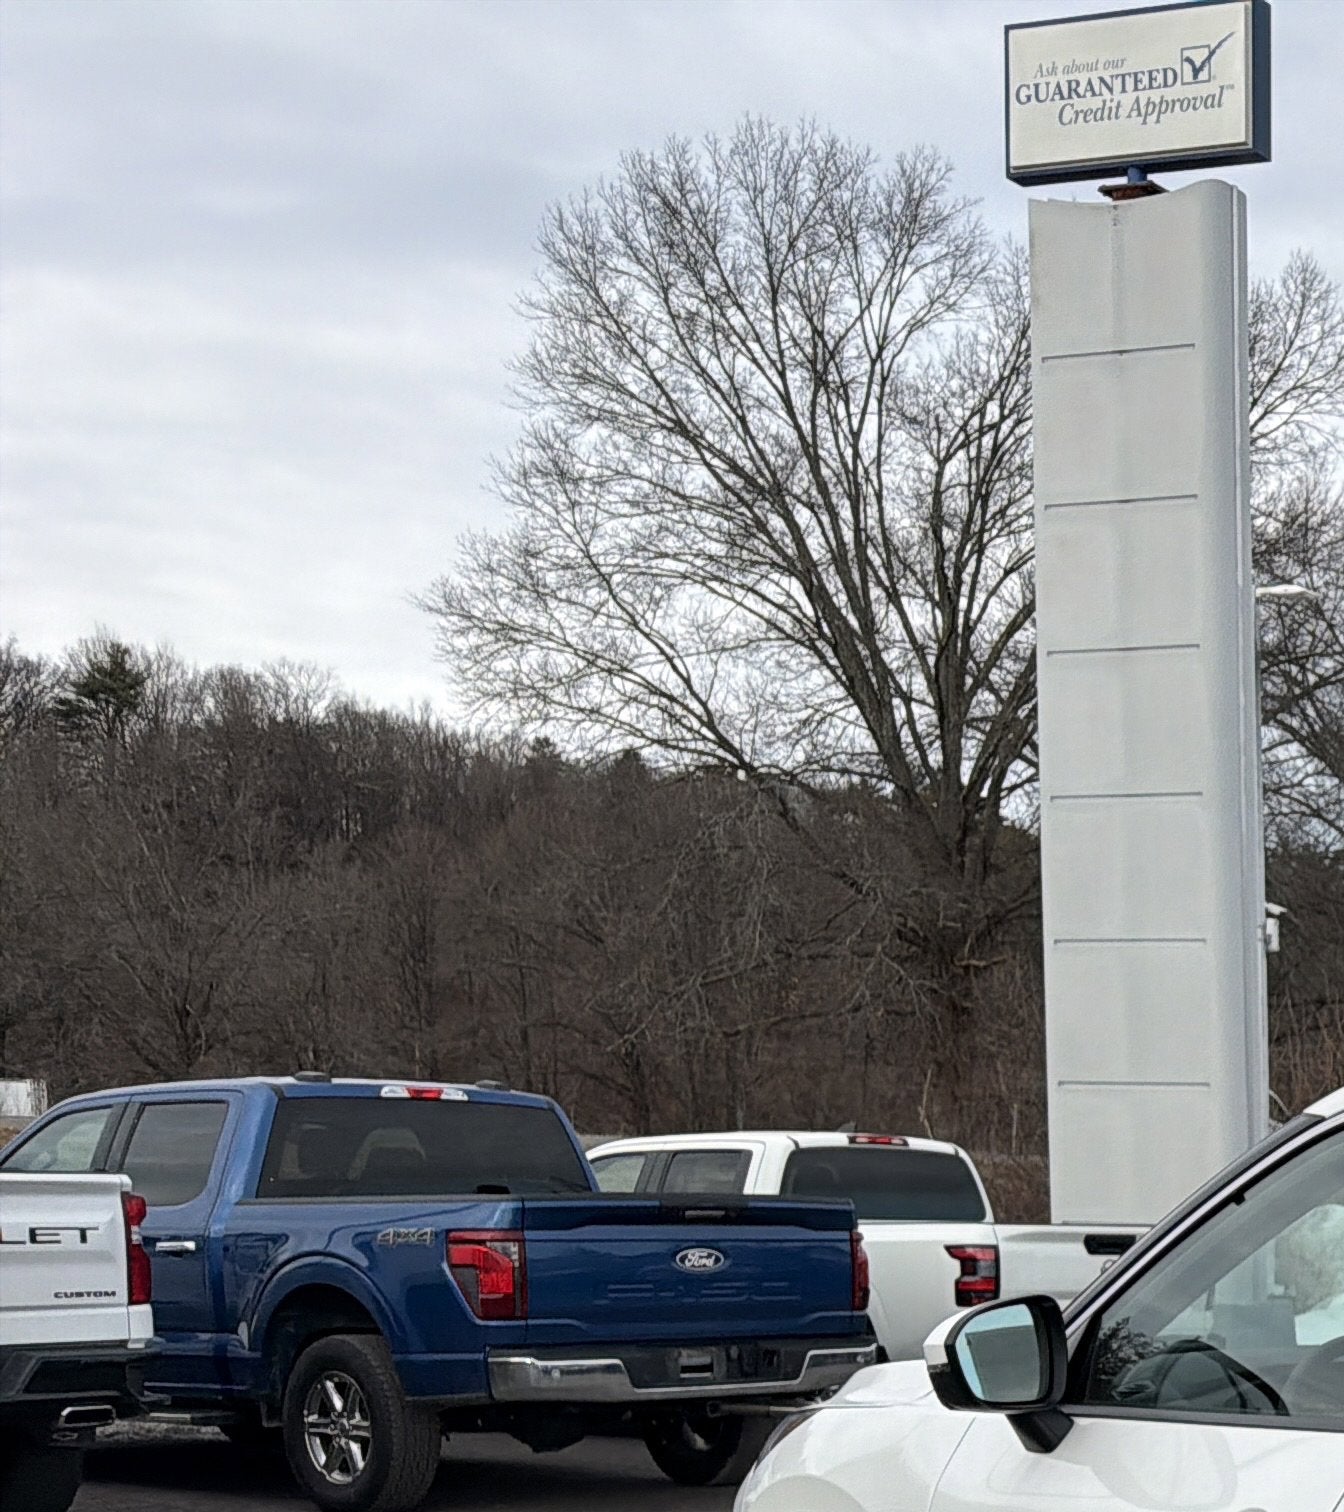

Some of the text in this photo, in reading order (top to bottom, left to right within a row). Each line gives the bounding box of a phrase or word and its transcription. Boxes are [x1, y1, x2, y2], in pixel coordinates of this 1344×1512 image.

[1034, 57, 1127, 79] Ask about our
[1015, 67, 1178, 105] GUARANTEED
[1058, 85, 1224, 126] Credit Approval
[685, 1251, 715, 1267] Ford
[54, 1290, 117, 1299] CUSTOM
